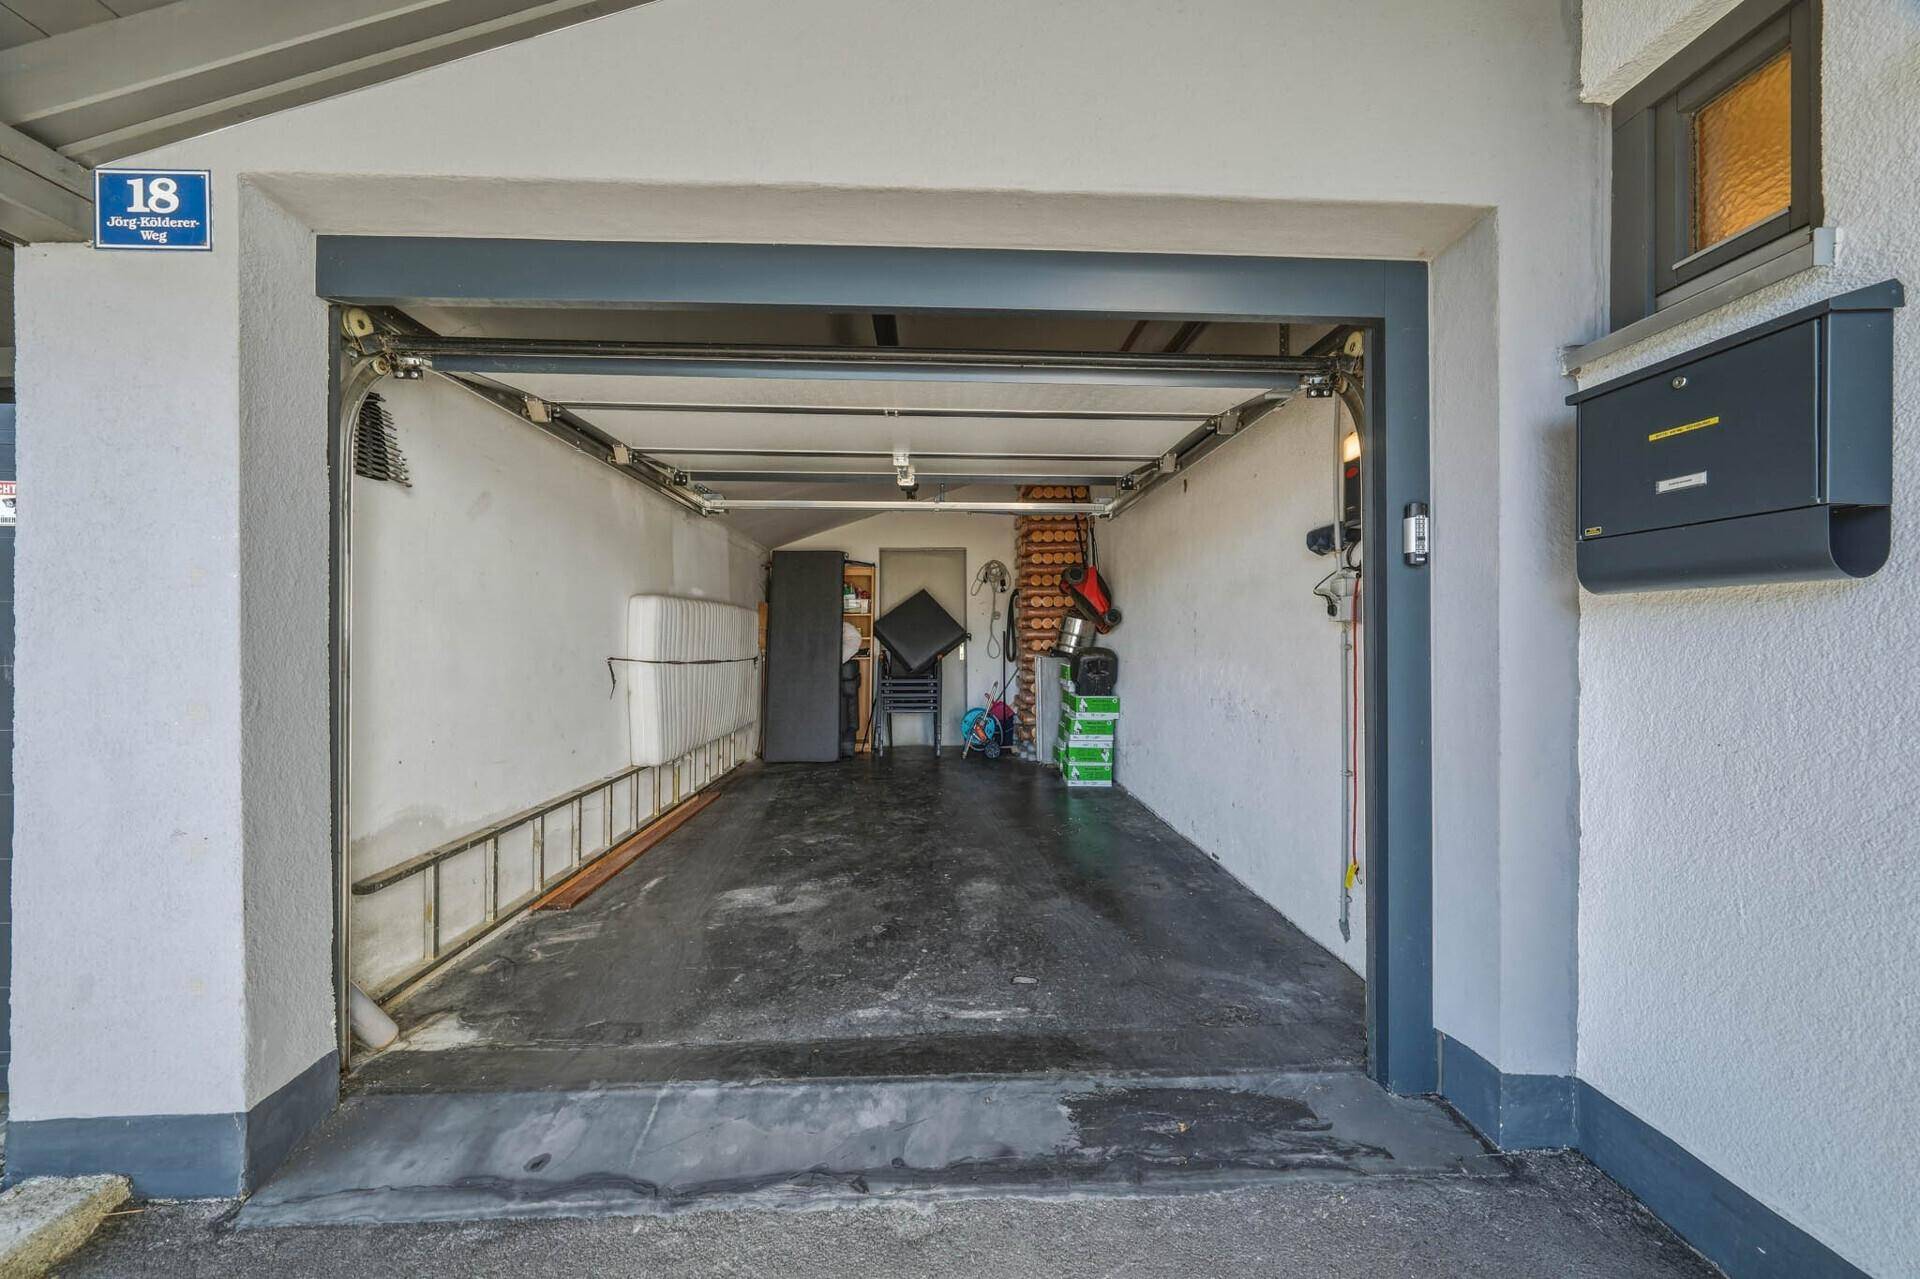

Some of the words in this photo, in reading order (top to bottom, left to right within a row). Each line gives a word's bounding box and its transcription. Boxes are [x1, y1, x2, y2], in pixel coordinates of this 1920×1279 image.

[126, 177, 180, 214] 18
[106, 215, 200, 230] Jörg-Kölderer-
[140, 230, 168, 244] Weg
